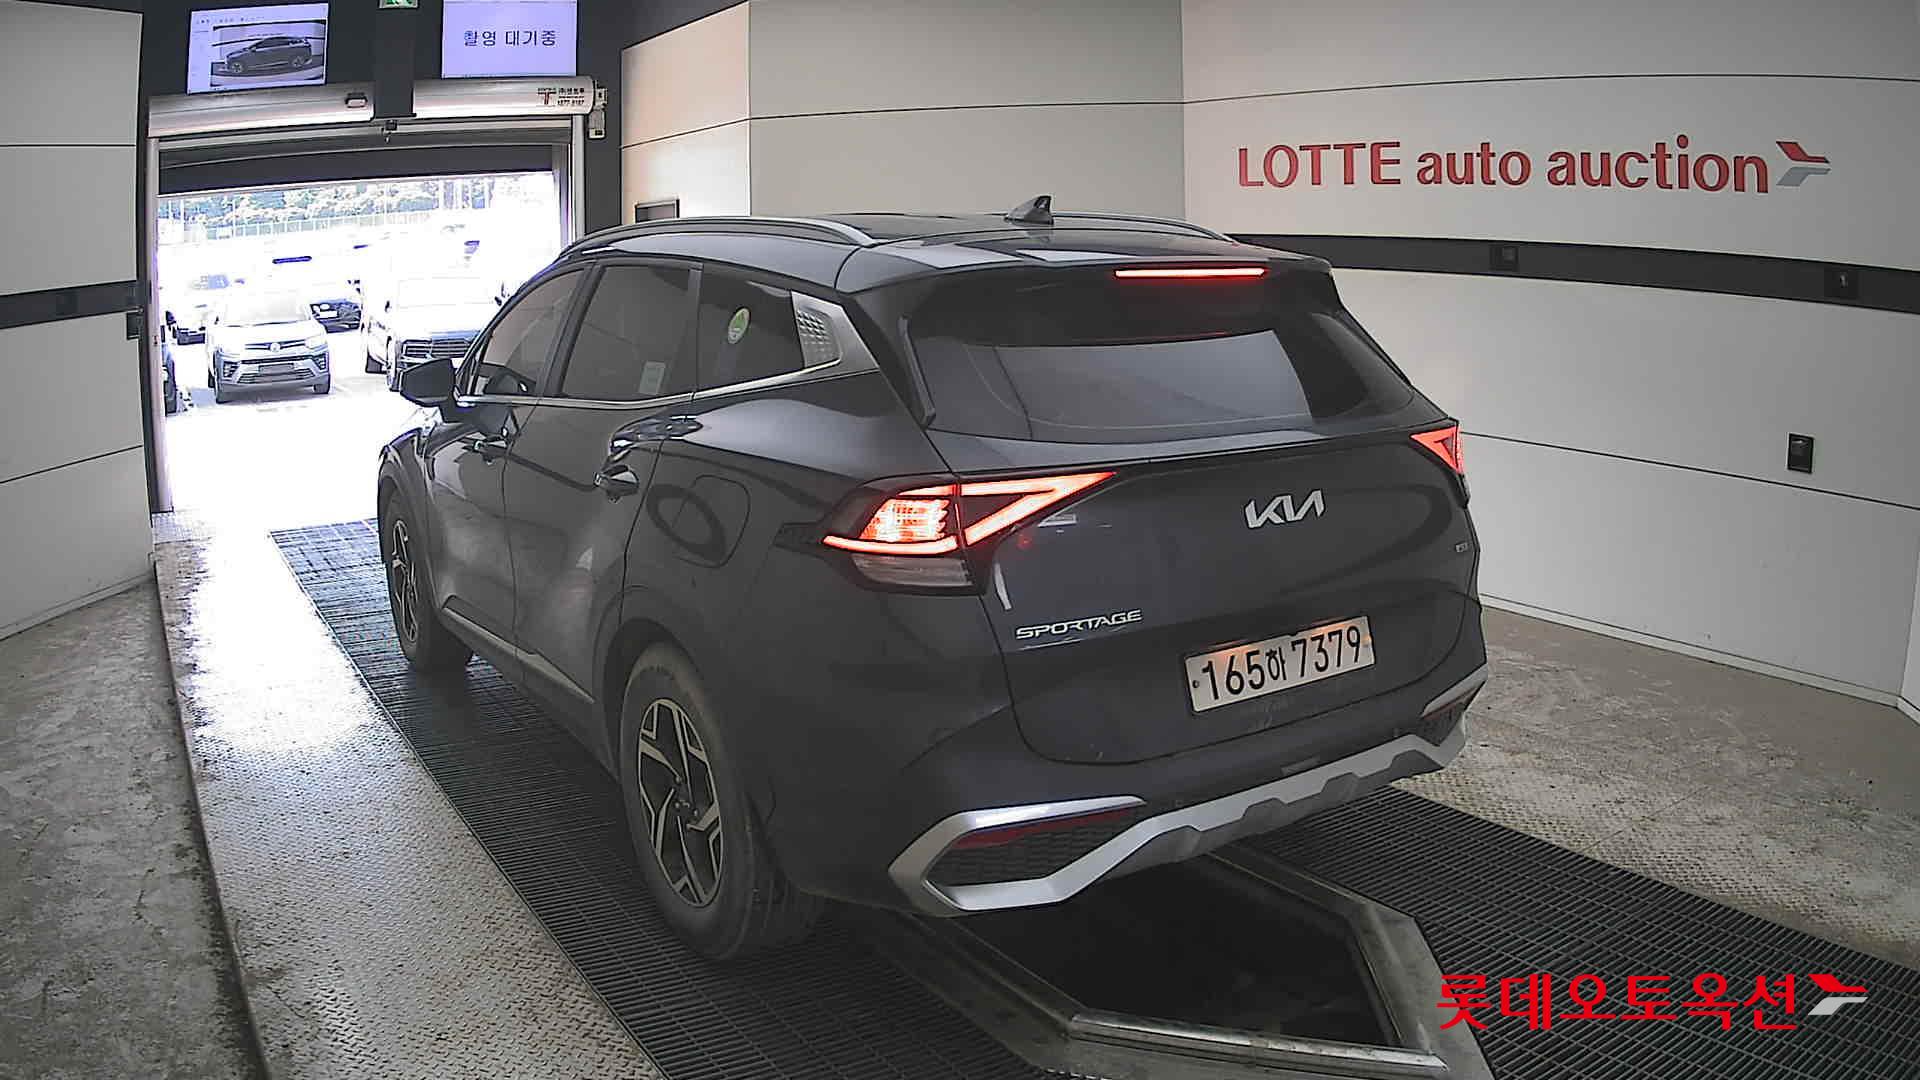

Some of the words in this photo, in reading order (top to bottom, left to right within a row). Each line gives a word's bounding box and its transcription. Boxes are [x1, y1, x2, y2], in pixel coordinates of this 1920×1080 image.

[505, 30, 556, 47] 대기중
[1238, 141, 1401, 189] LOTTE
[1416, 142, 1532, 187] auto
[1546, 134, 1770, 194] auction
[1244, 489, 1325, 529] KIA
[1015, 609, 1143, 640] SPORTAGE
[1201, 646, 1288, 701] 165하
[1291, 625, 1362, 678] 7379
